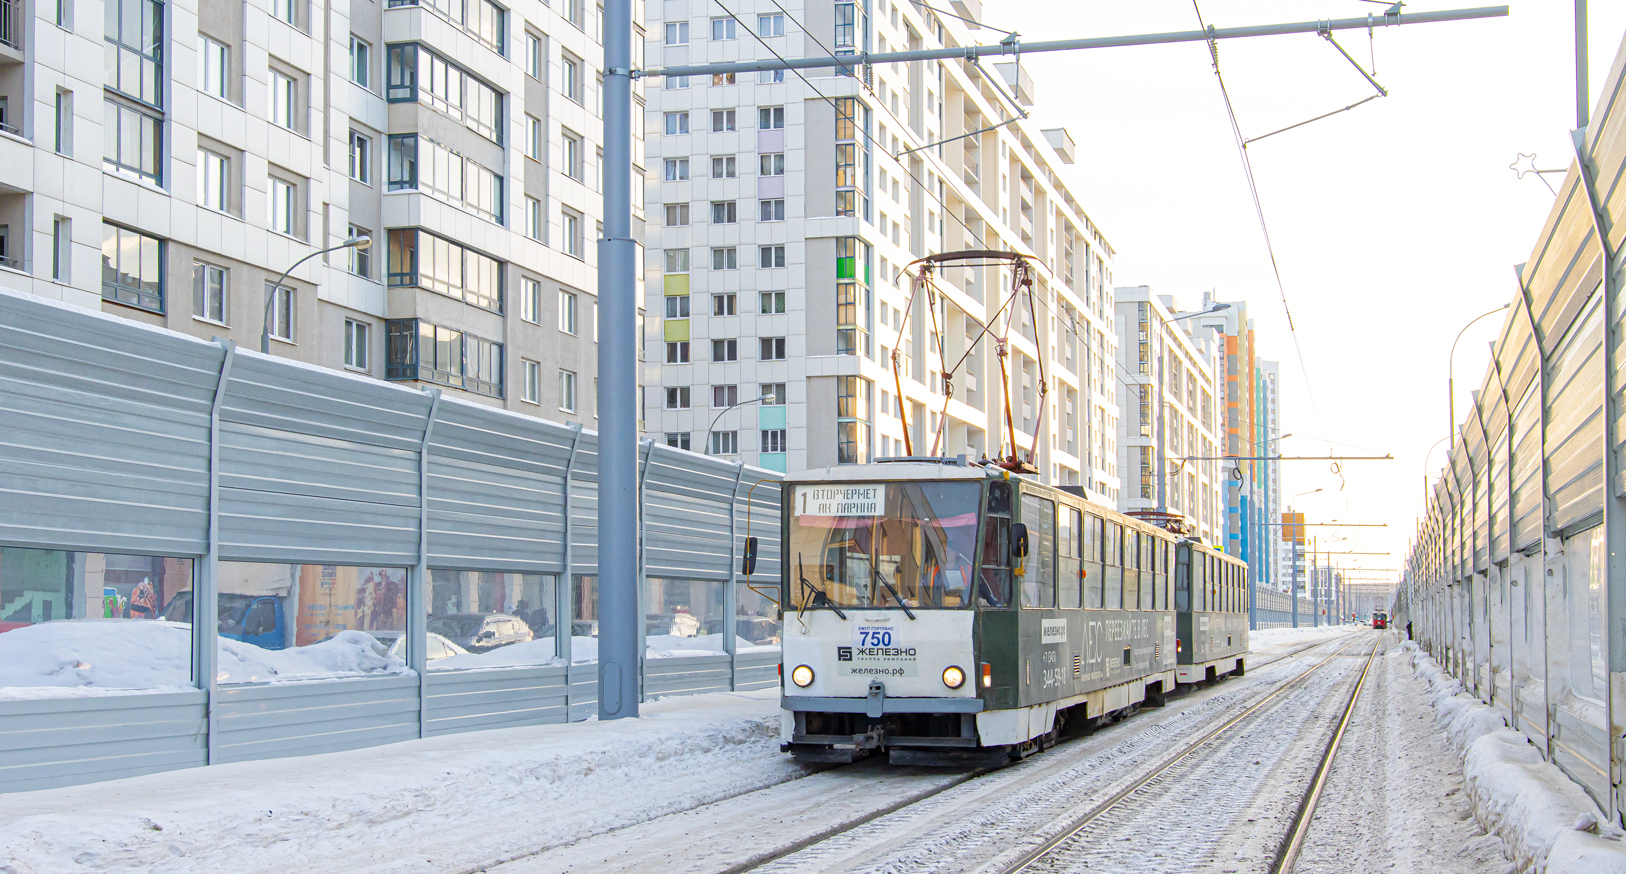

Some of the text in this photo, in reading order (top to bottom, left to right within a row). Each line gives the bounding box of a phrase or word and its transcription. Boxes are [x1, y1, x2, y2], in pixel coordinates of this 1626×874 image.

[812, 488, 878, 500] ВТОРЧЕРМЕТ
[801, 492, 807, 514] 1
[836, 502, 877, 513] ПАРИНА
[860, 631, 892, 647] 750
[856, 647, 917, 656] ЖЕЛЕЗНО
[850, 667, 905, 677] железно.рф
